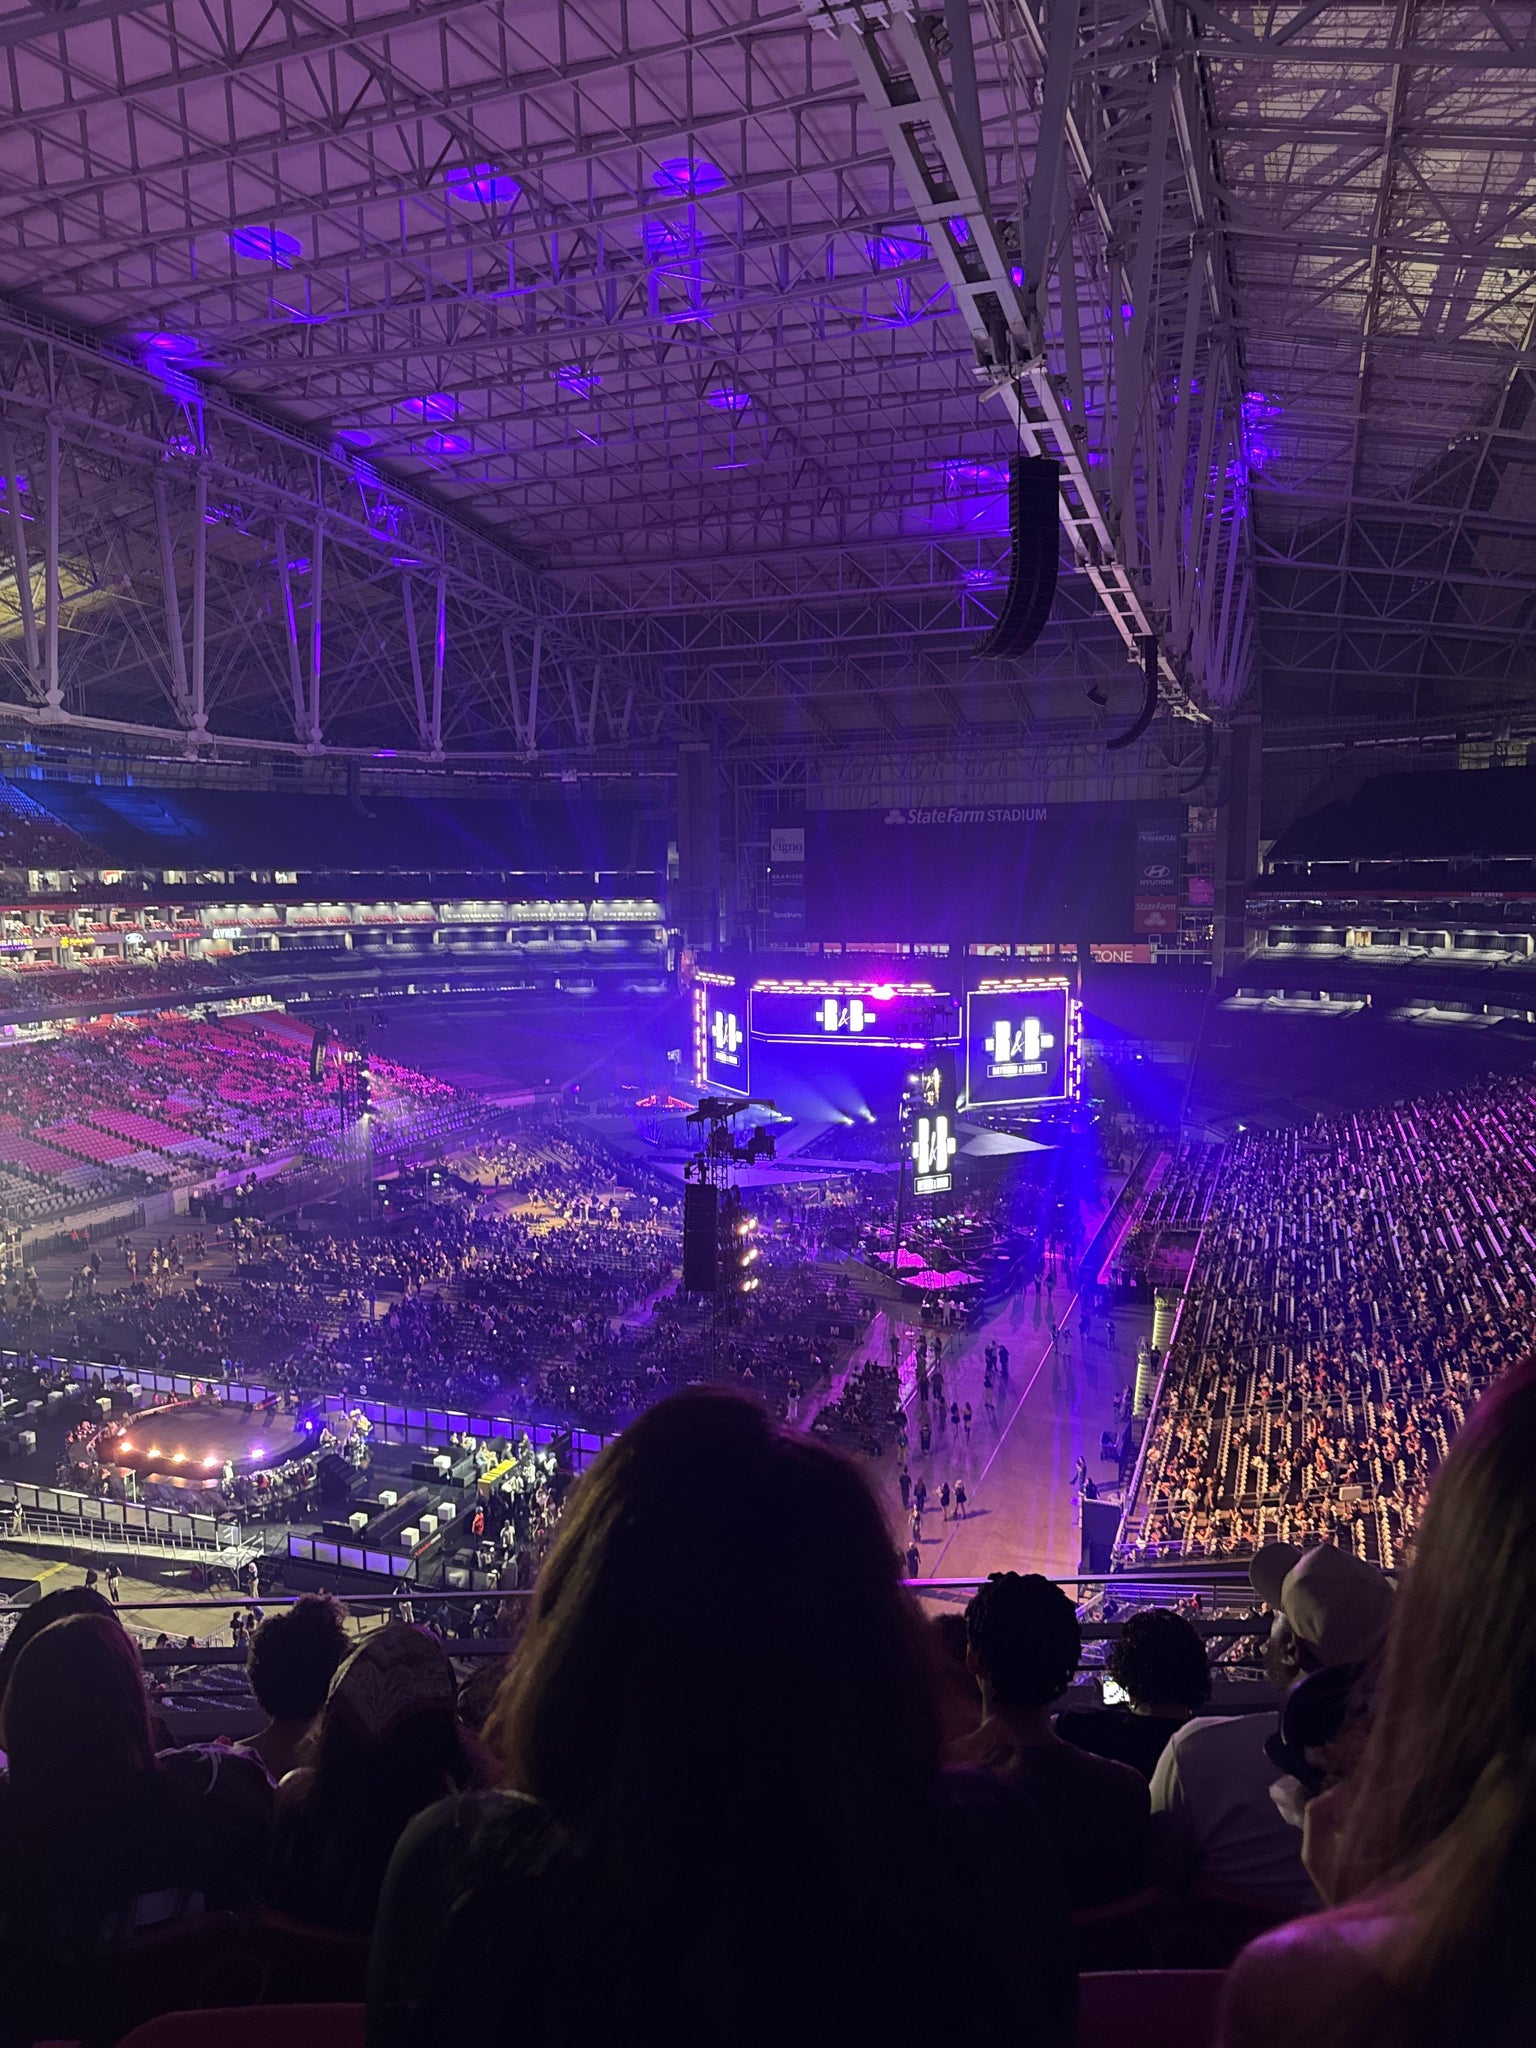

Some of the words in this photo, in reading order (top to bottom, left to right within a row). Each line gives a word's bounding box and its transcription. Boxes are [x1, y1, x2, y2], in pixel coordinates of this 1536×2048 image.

[986, 807, 1047, 823] STADIUM
[477, 1287, 488, 1298] N
[829, 1325, 840, 1336] M
[358, 1384, 368, 1396] S
